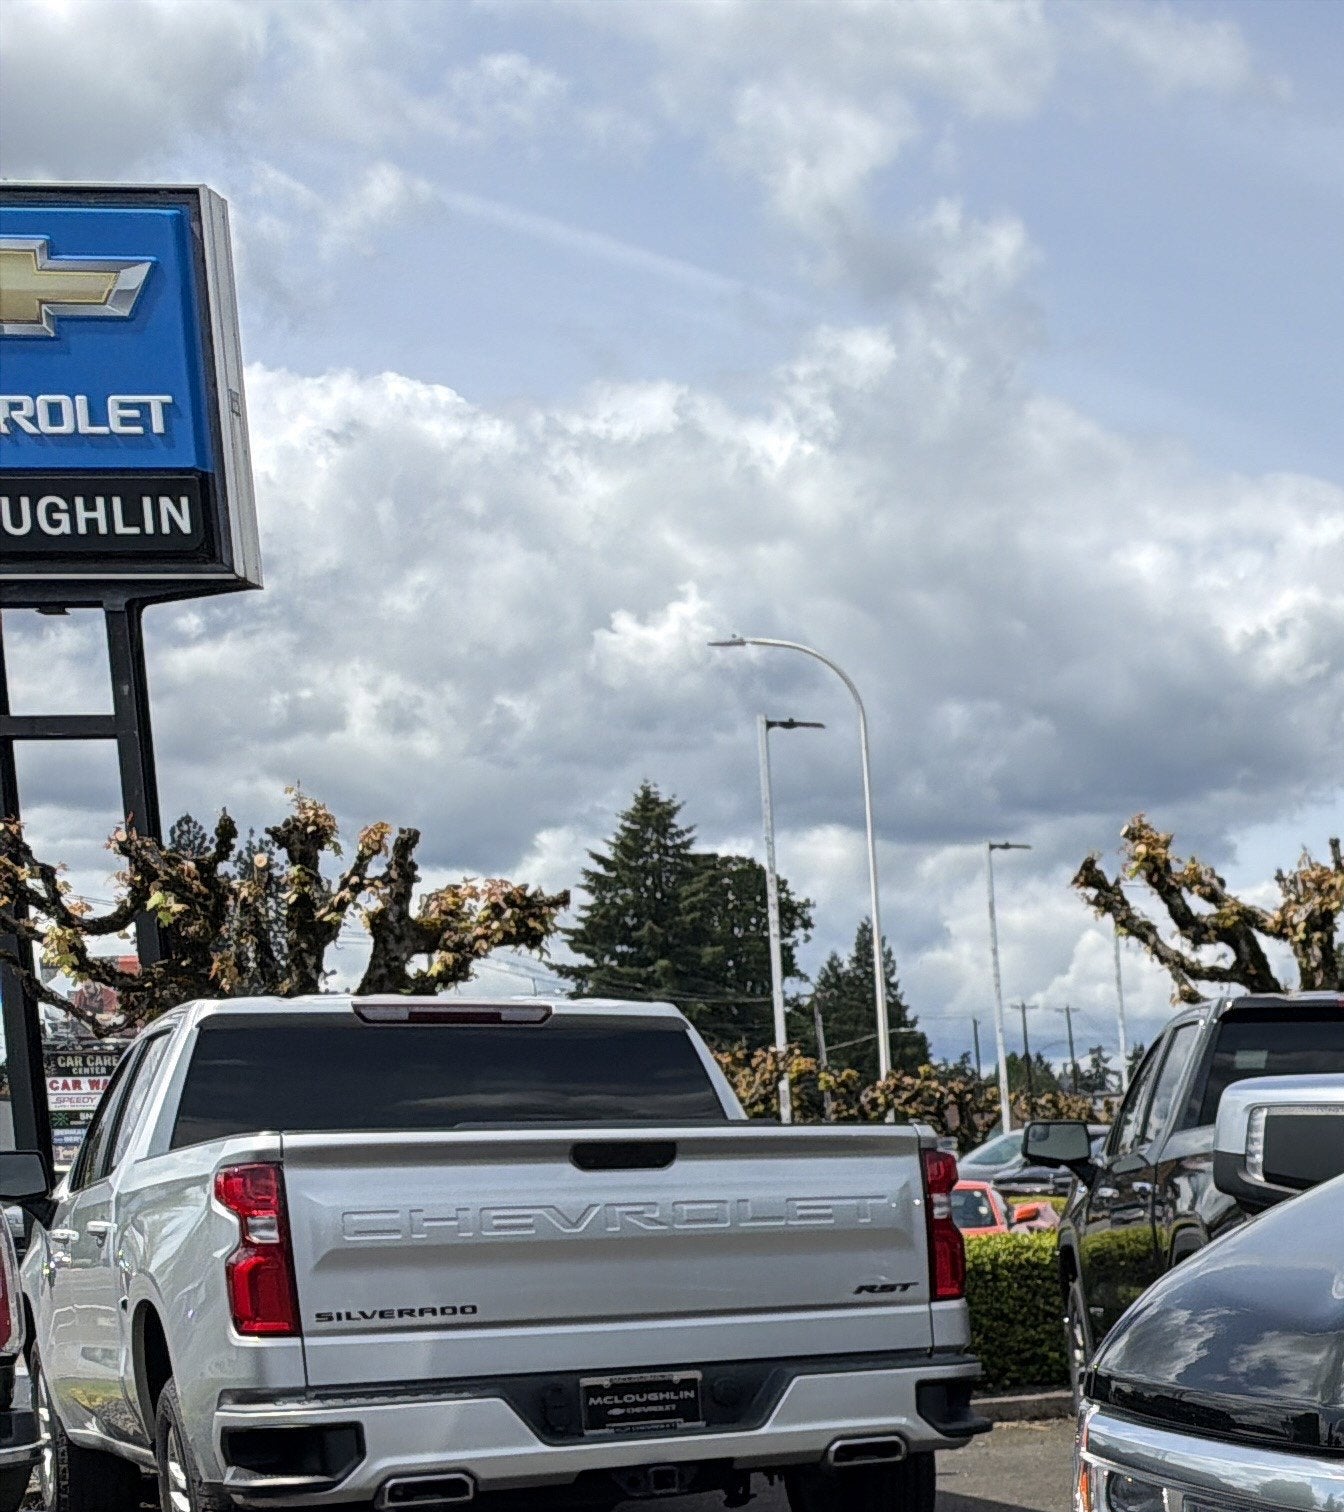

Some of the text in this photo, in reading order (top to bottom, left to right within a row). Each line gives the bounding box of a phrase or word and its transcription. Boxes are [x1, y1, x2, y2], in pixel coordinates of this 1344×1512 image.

[57, 1055, 83, 1068] CAR
[49, 1079, 83, 1091] CAR
[341, 1194, 890, 1242] CHEVROLET
[853, 1281, 920, 1296] RST
[314, 1303, 479, 1323] SILVERADO
[588, 1389, 696, 1406] MCLOUGHLIN
